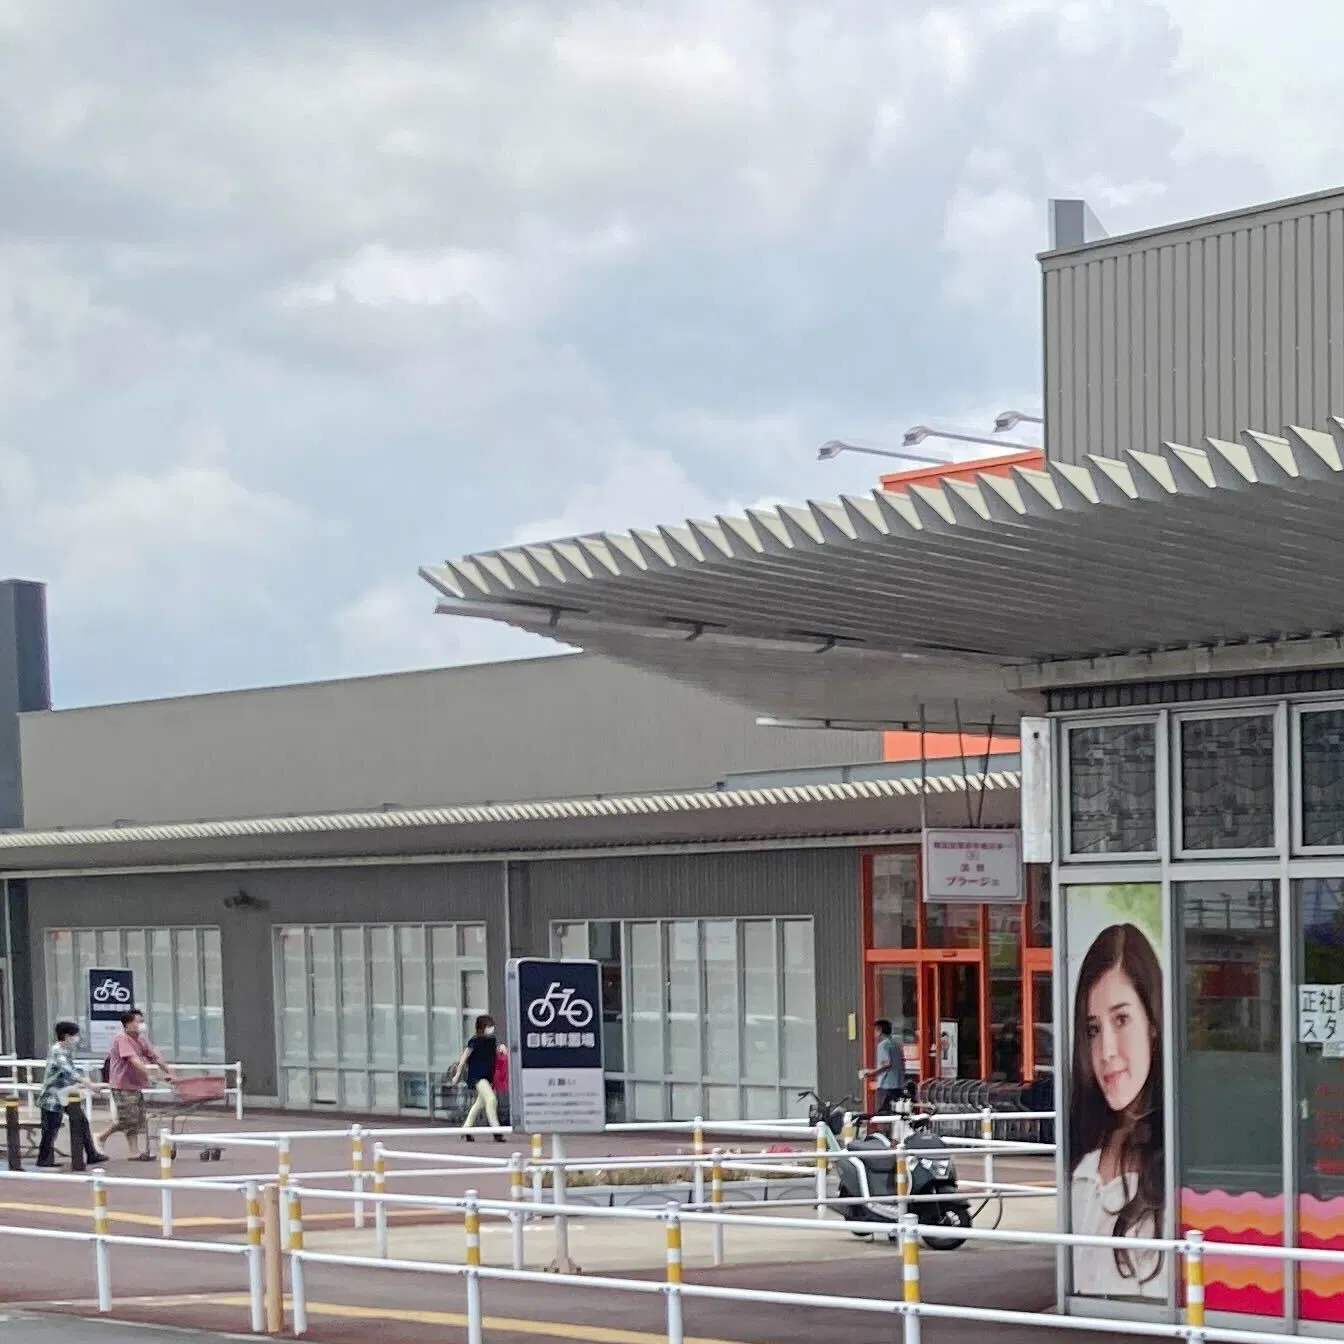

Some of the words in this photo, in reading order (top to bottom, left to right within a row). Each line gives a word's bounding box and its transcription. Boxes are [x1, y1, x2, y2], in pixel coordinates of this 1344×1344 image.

[527, 1032, 596, 1049] 自転車置場
